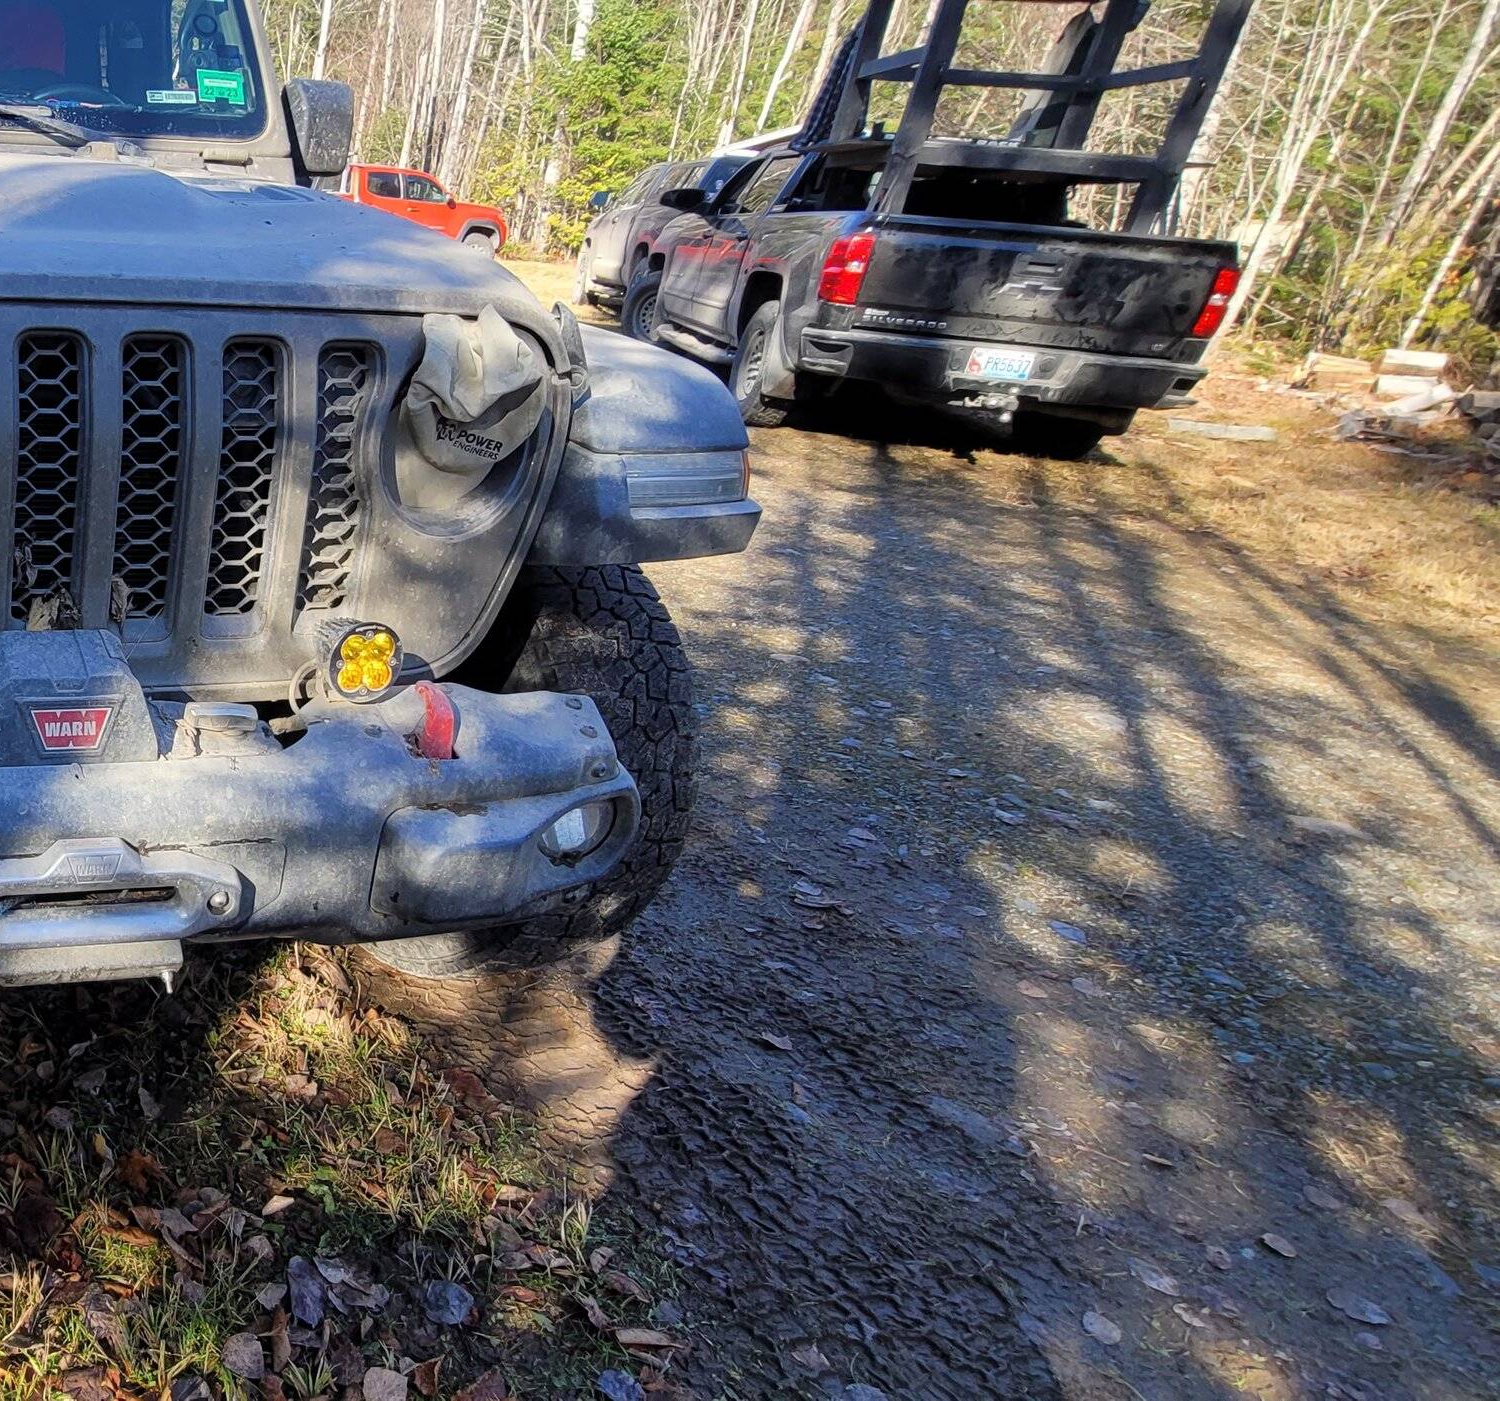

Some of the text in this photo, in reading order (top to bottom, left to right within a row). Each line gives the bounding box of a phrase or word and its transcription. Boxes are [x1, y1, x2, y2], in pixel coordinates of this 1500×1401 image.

[204, 87, 214, 95] 22
[227, 89, 238, 97] 23
[862, 315, 947, 329] SILVERADO
[457, 430, 503, 452] POWER
[453, 440, 499, 460] ENGINEERS
[45, 721, 96, 737] WARN
[75, 863, 112, 876] WARN
